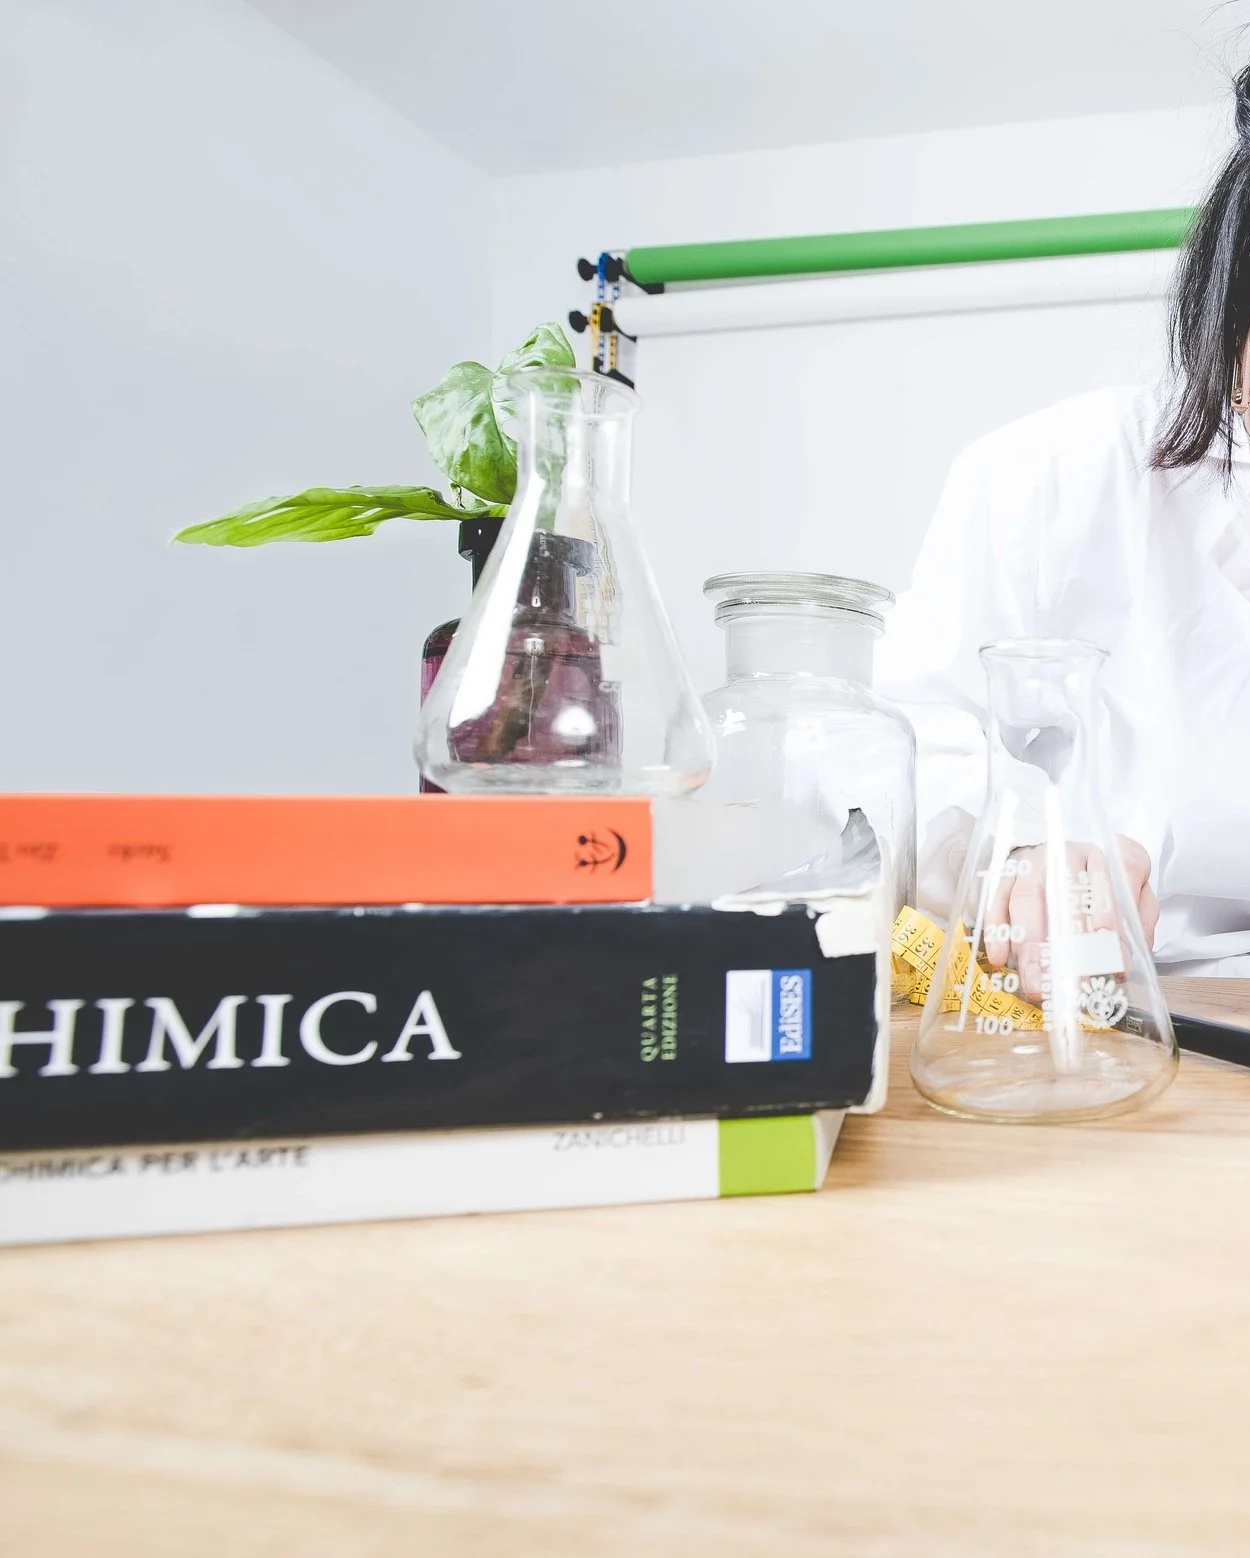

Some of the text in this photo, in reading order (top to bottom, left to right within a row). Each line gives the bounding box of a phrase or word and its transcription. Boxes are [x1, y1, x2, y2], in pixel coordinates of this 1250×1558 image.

[985, 923, 1026, 944] 200
[980, 972, 1019, 994] 150
[640, 977, 660, 1063] QUARTA
[661, 972, 678, 1061] EDIZIONE
[778, 975, 804, 1055] EdiSES
[975, 1016, 1014, 1035] 100
[553, 1126, 688, 1152] ZANICHELLI
[140, 1149, 199, 1175] PER
